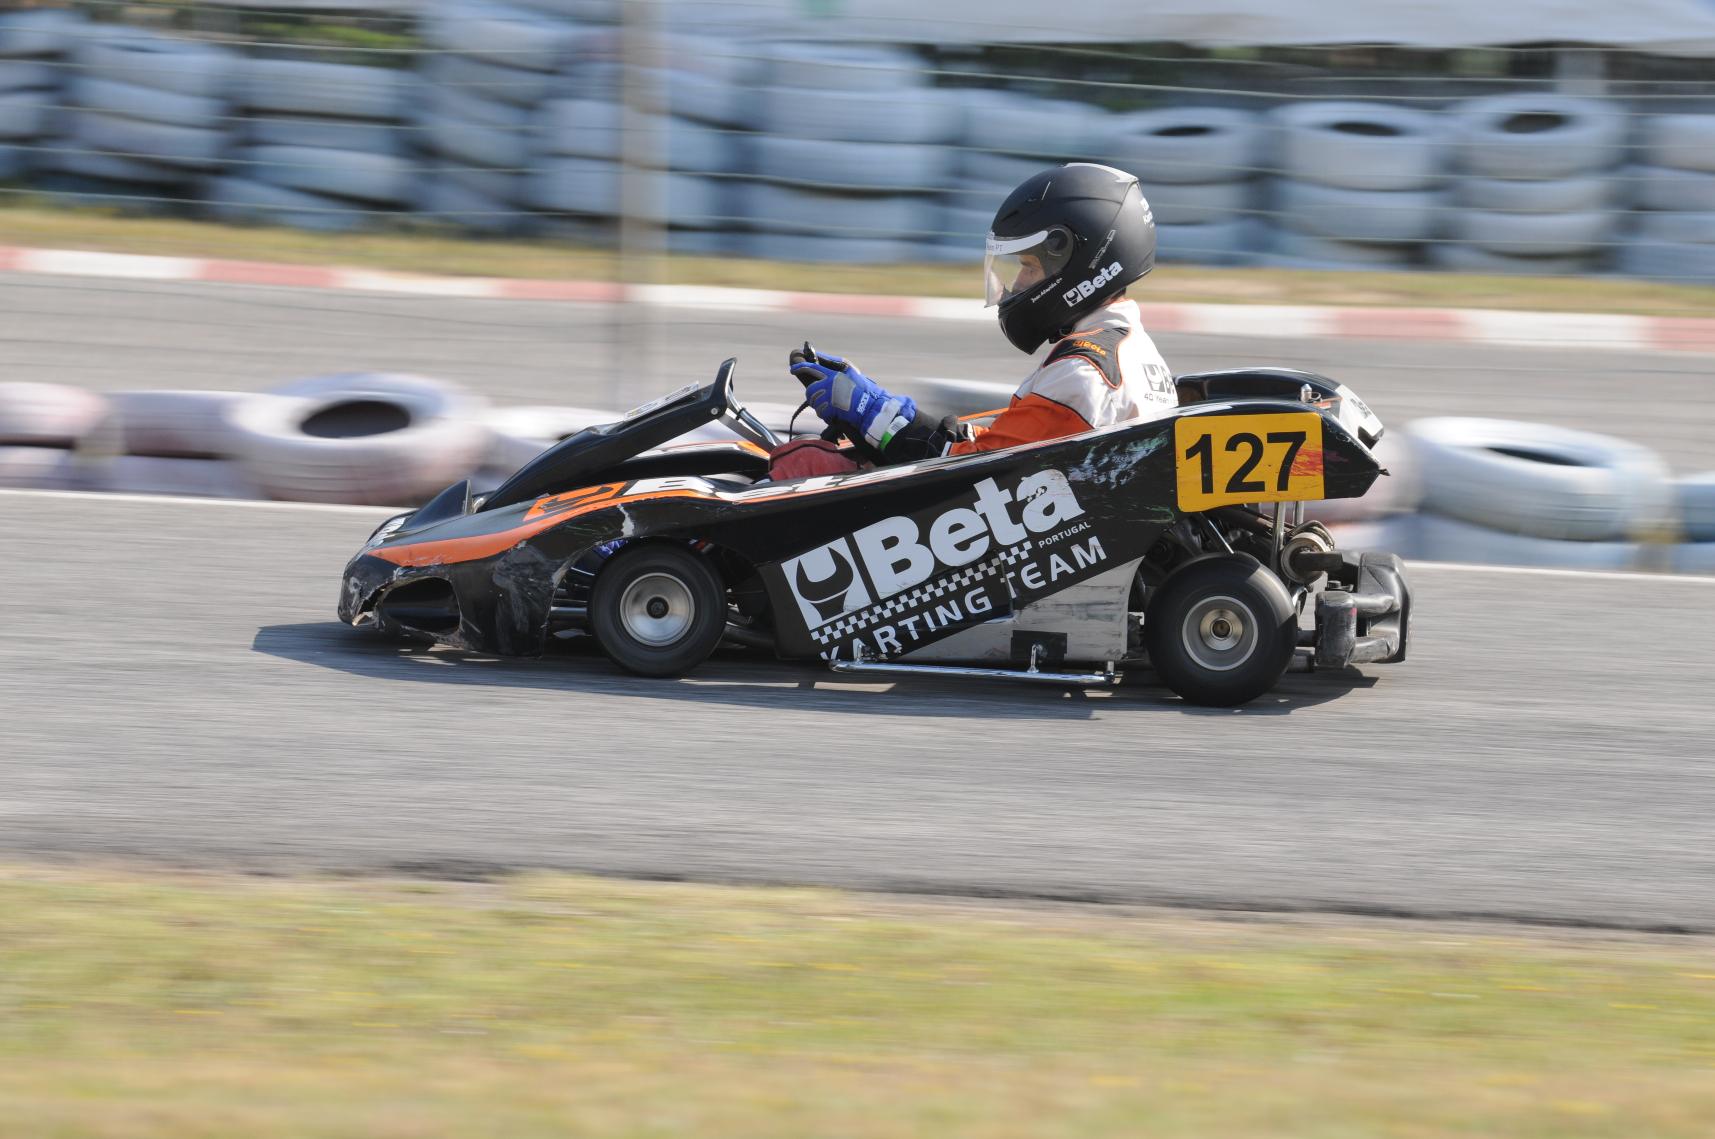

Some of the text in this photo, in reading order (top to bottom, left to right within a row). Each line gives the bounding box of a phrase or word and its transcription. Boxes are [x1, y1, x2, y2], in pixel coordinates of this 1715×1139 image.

[1077, 261, 1124, 298] Beta
[1185, 431, 1308, 495] 127
[853, 468, 1086, 600] Beta
[1038, 521, 1092, 549] PORTUGAL
[1000, 535, 1108, 600] TEAM
